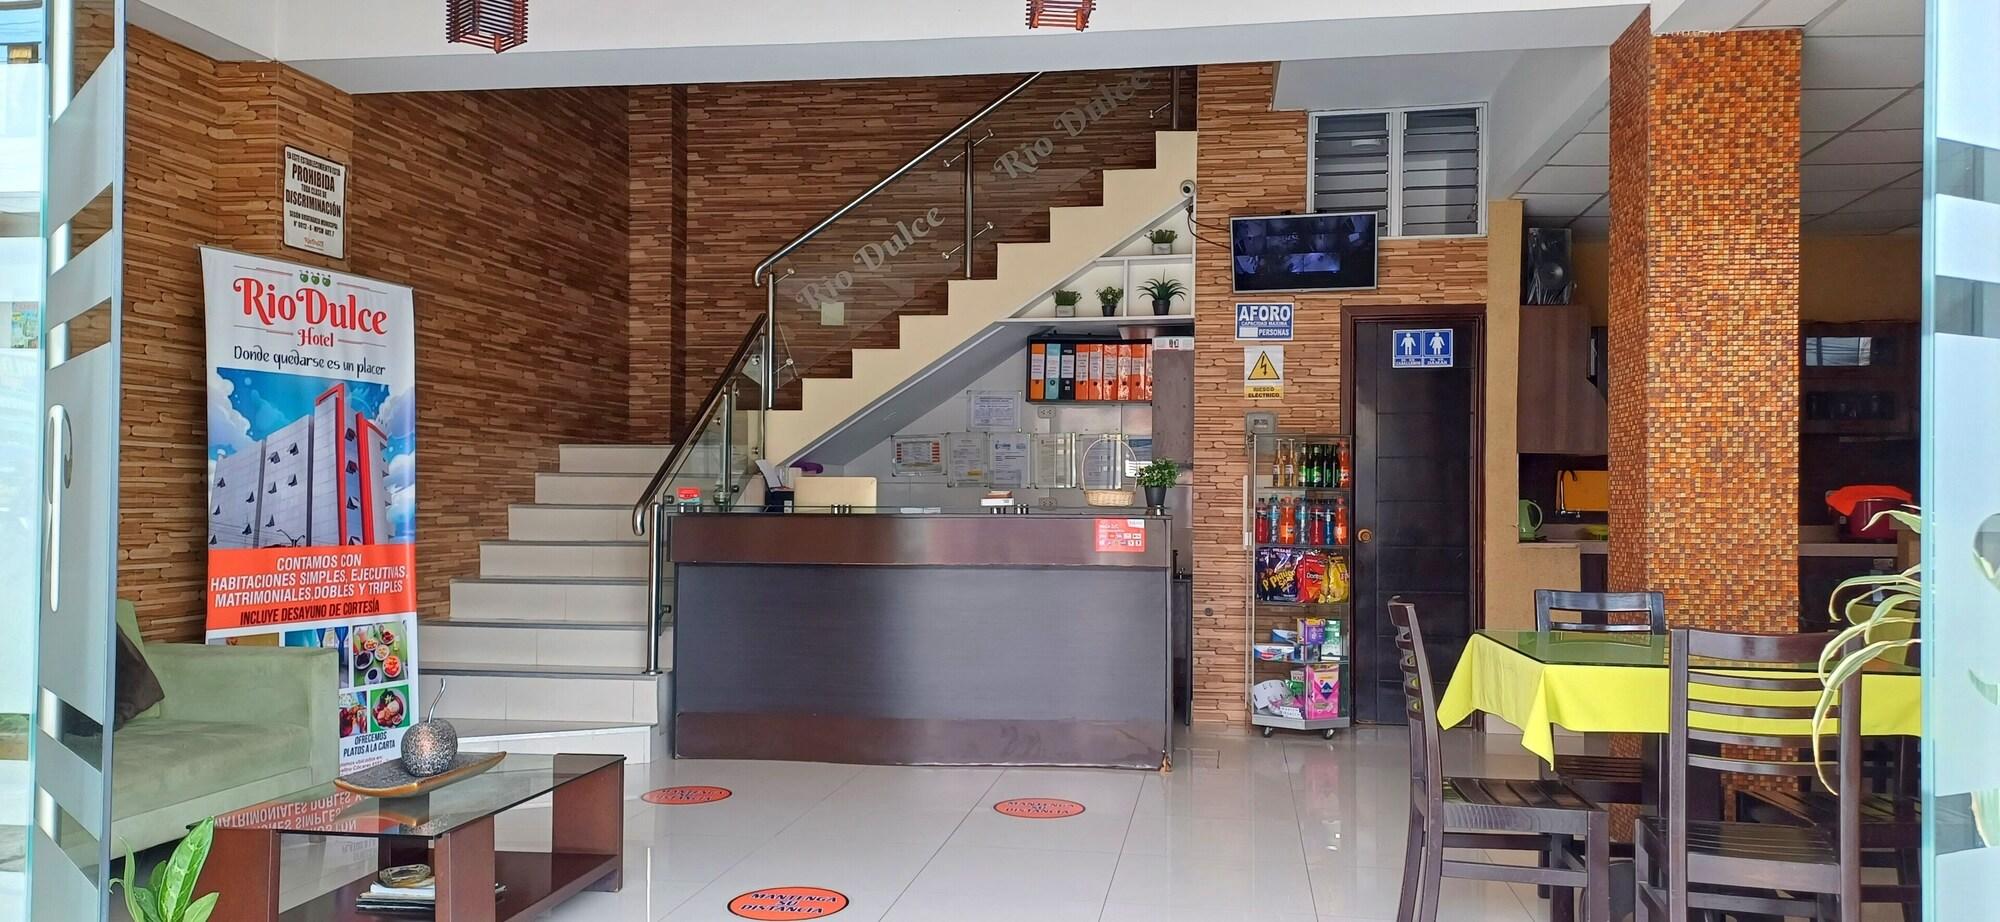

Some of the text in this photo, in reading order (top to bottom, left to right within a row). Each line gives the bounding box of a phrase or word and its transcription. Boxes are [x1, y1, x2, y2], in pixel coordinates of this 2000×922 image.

[993, 70, 1152, 178] Rio Dulce
[292, 163, 335, 192] PROHIBIDA
[286, 188, 341, 218] DISCRIMINACIÓN
[794, 206, 946, 311] Rio Dulce
[1239, 306, 1290, 322] AFORO
[297, 327, 334, 347] Hotel
[1258, 328, 1290, 336] PERSONAS
[234, 345, 386, 378] Donde quedarse es un placer
[276, 554, 362, 572] CONTAMOS CON
[210, 572, 296, 592] HABITACIONES
[300, 569, 348, 586] SIMPLES,
[358, 582, 366, 594] Y
[368, 580, 403, 594] TRIPLES
[240, 598, 380, 626] INCLUYE DESAYUNO DE CORTESÍA
[354, 731, 388, 746] OFRECEMOS
[343, 740, 396, 758] PLATOS A LA CARTA
[752, 893, 837, 902] MANTENGA
[741, 904, 823, 913] DISTANCIA
